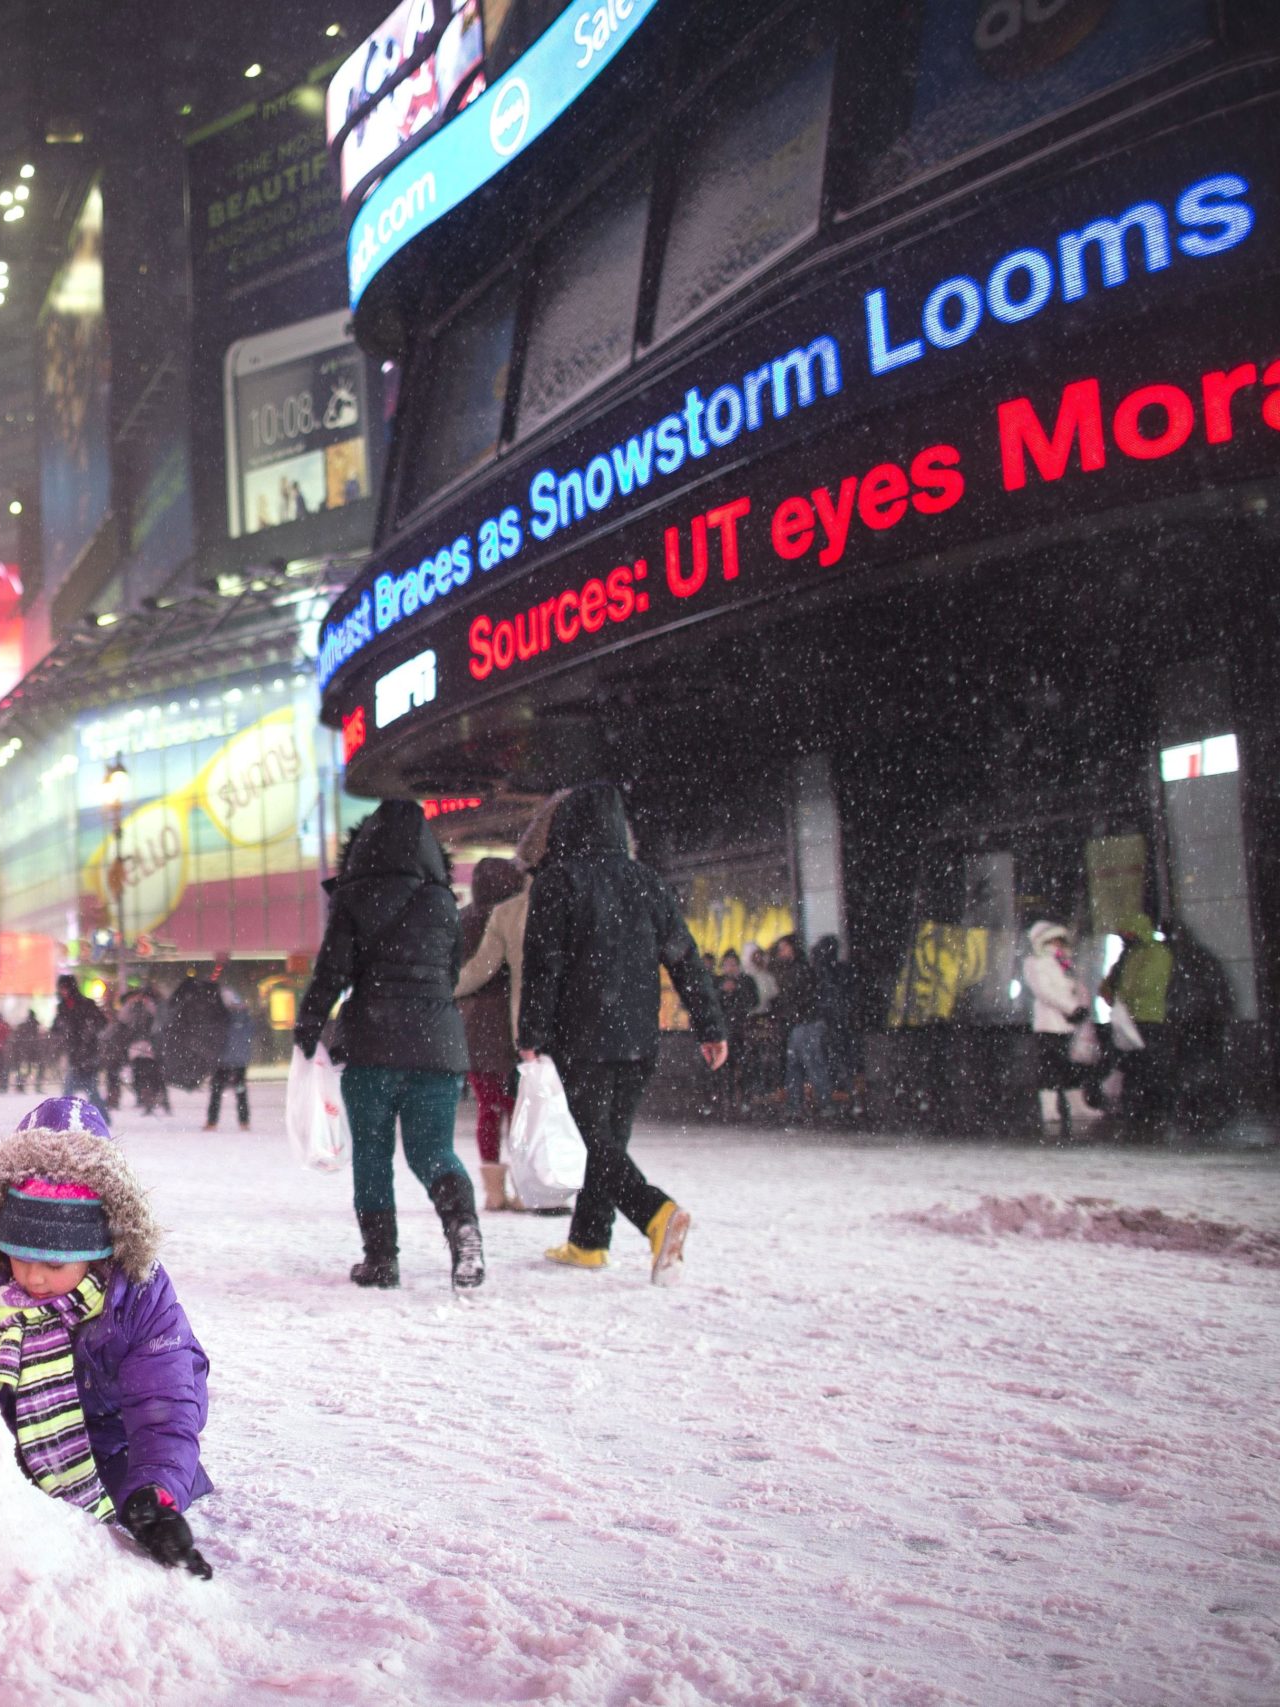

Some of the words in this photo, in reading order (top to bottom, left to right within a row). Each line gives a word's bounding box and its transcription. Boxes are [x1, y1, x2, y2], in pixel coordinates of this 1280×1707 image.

[207, 151, 329, 229] BEAUTIF
[373, 536, 472, 633] Braces
[478, 507, 522, 571] as
[528, 337, 840, 541] Snowstorm
[865, 175, 1253, 375] Looms
[469, 559, 649, 680] Sources:
[664, 497, 750, 598] UT
[771, 445, 964, 567] eyes
[118, 826, 181, 889] ello
